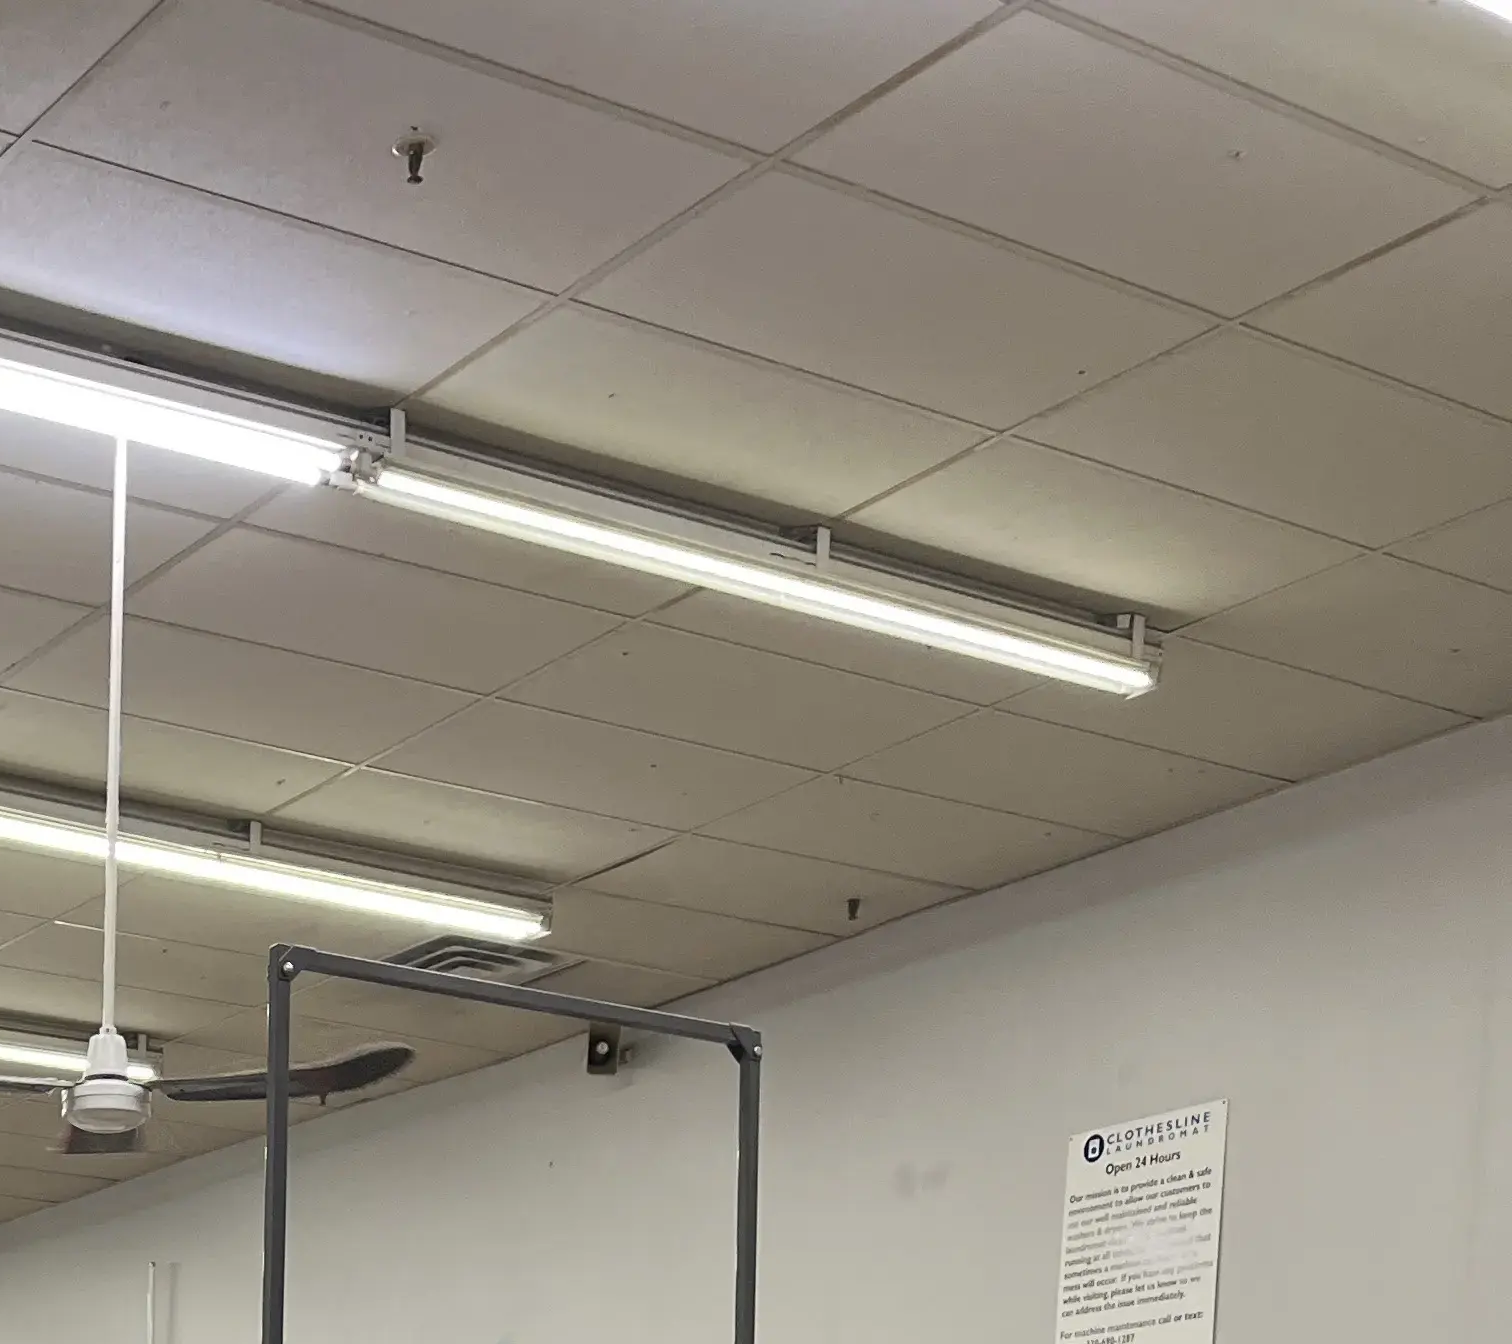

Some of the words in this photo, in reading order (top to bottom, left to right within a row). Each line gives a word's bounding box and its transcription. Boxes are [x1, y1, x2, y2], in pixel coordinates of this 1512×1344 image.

[1106, 1124, 1209, 1155] LAUNDROMAT
[1107, 1111, 1211, 1144] CLOTHESLINE
[1106, 1161, 1132, 1176] Open
[1136, 1156, 1146, 1168] 24
[1150, 1151, 1180, 1165] Hours
[1197, 1166, 1212, 1177] safe
